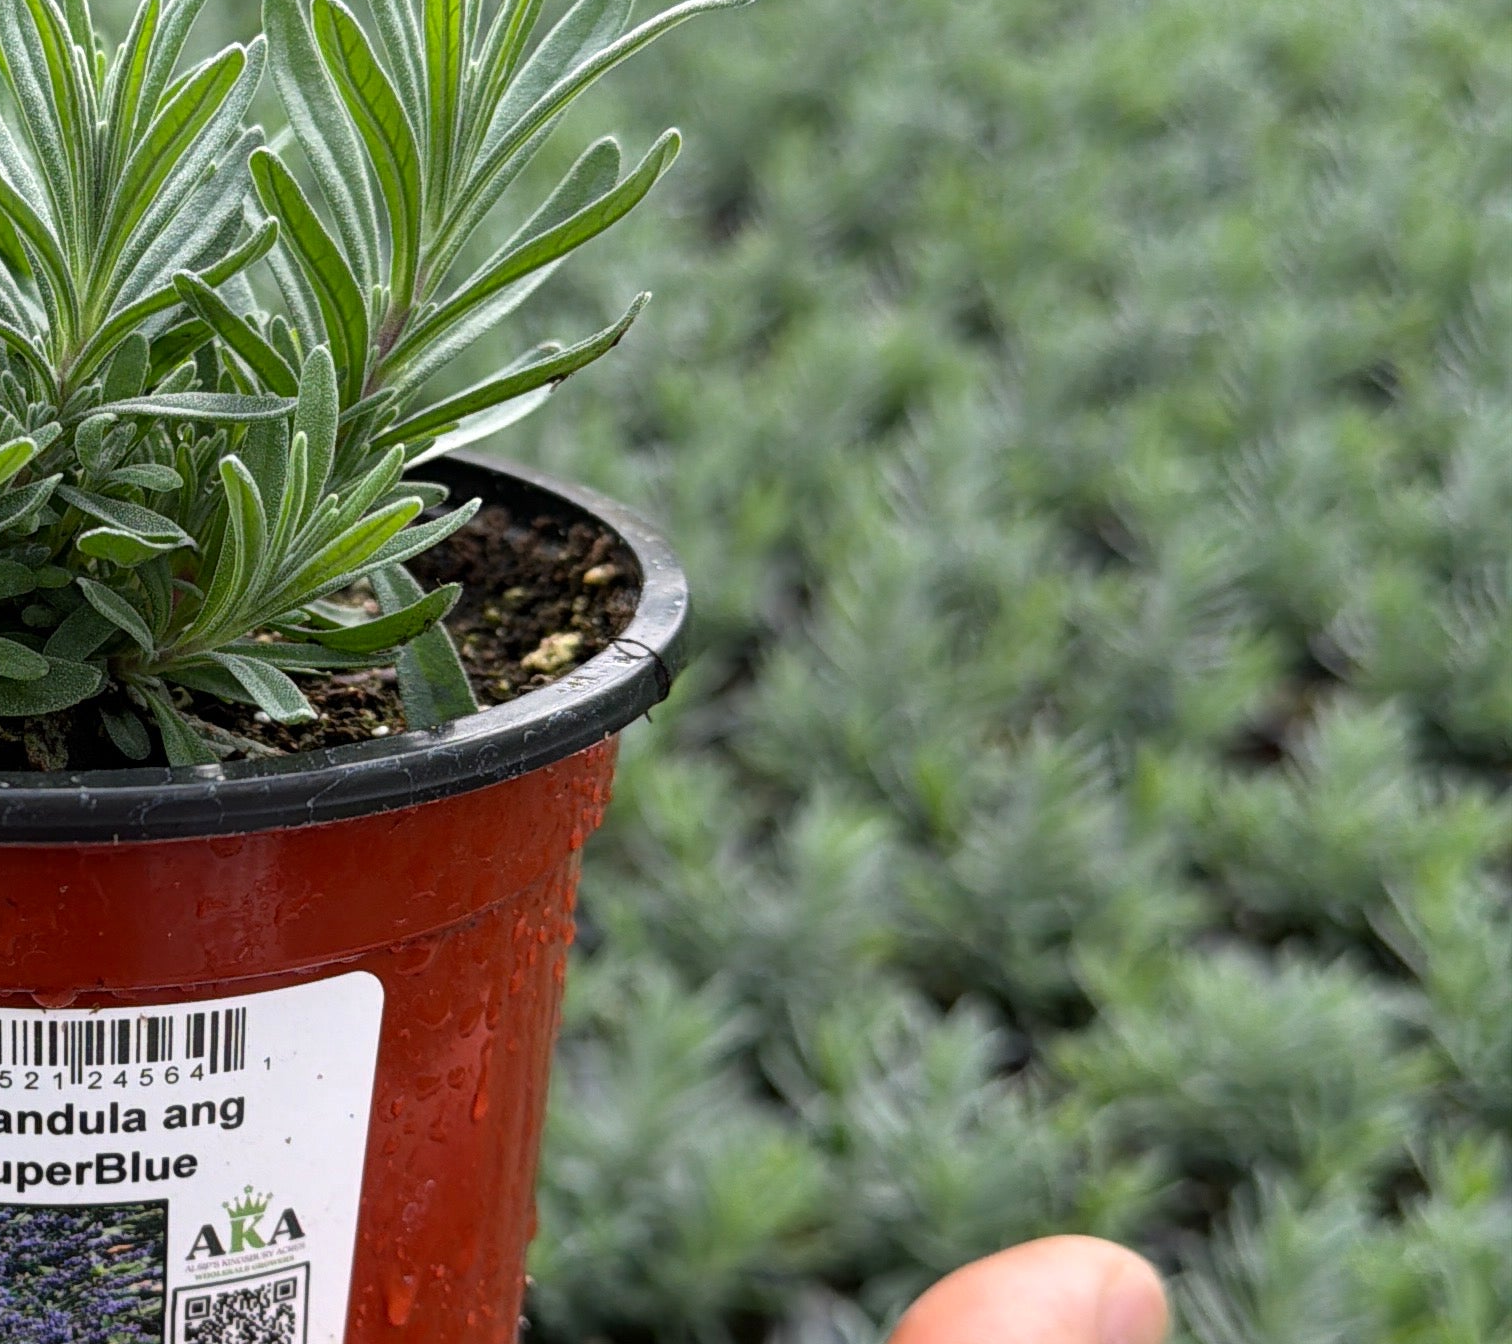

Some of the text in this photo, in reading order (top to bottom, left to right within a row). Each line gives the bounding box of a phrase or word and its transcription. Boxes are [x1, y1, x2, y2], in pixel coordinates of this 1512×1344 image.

[87, 1063, 206, 1091] 24564
[264, 1056, 272, 1071] 1
[163, 1094, 246, 1130] ang
[185, 1207, 306, 1261] AKA
